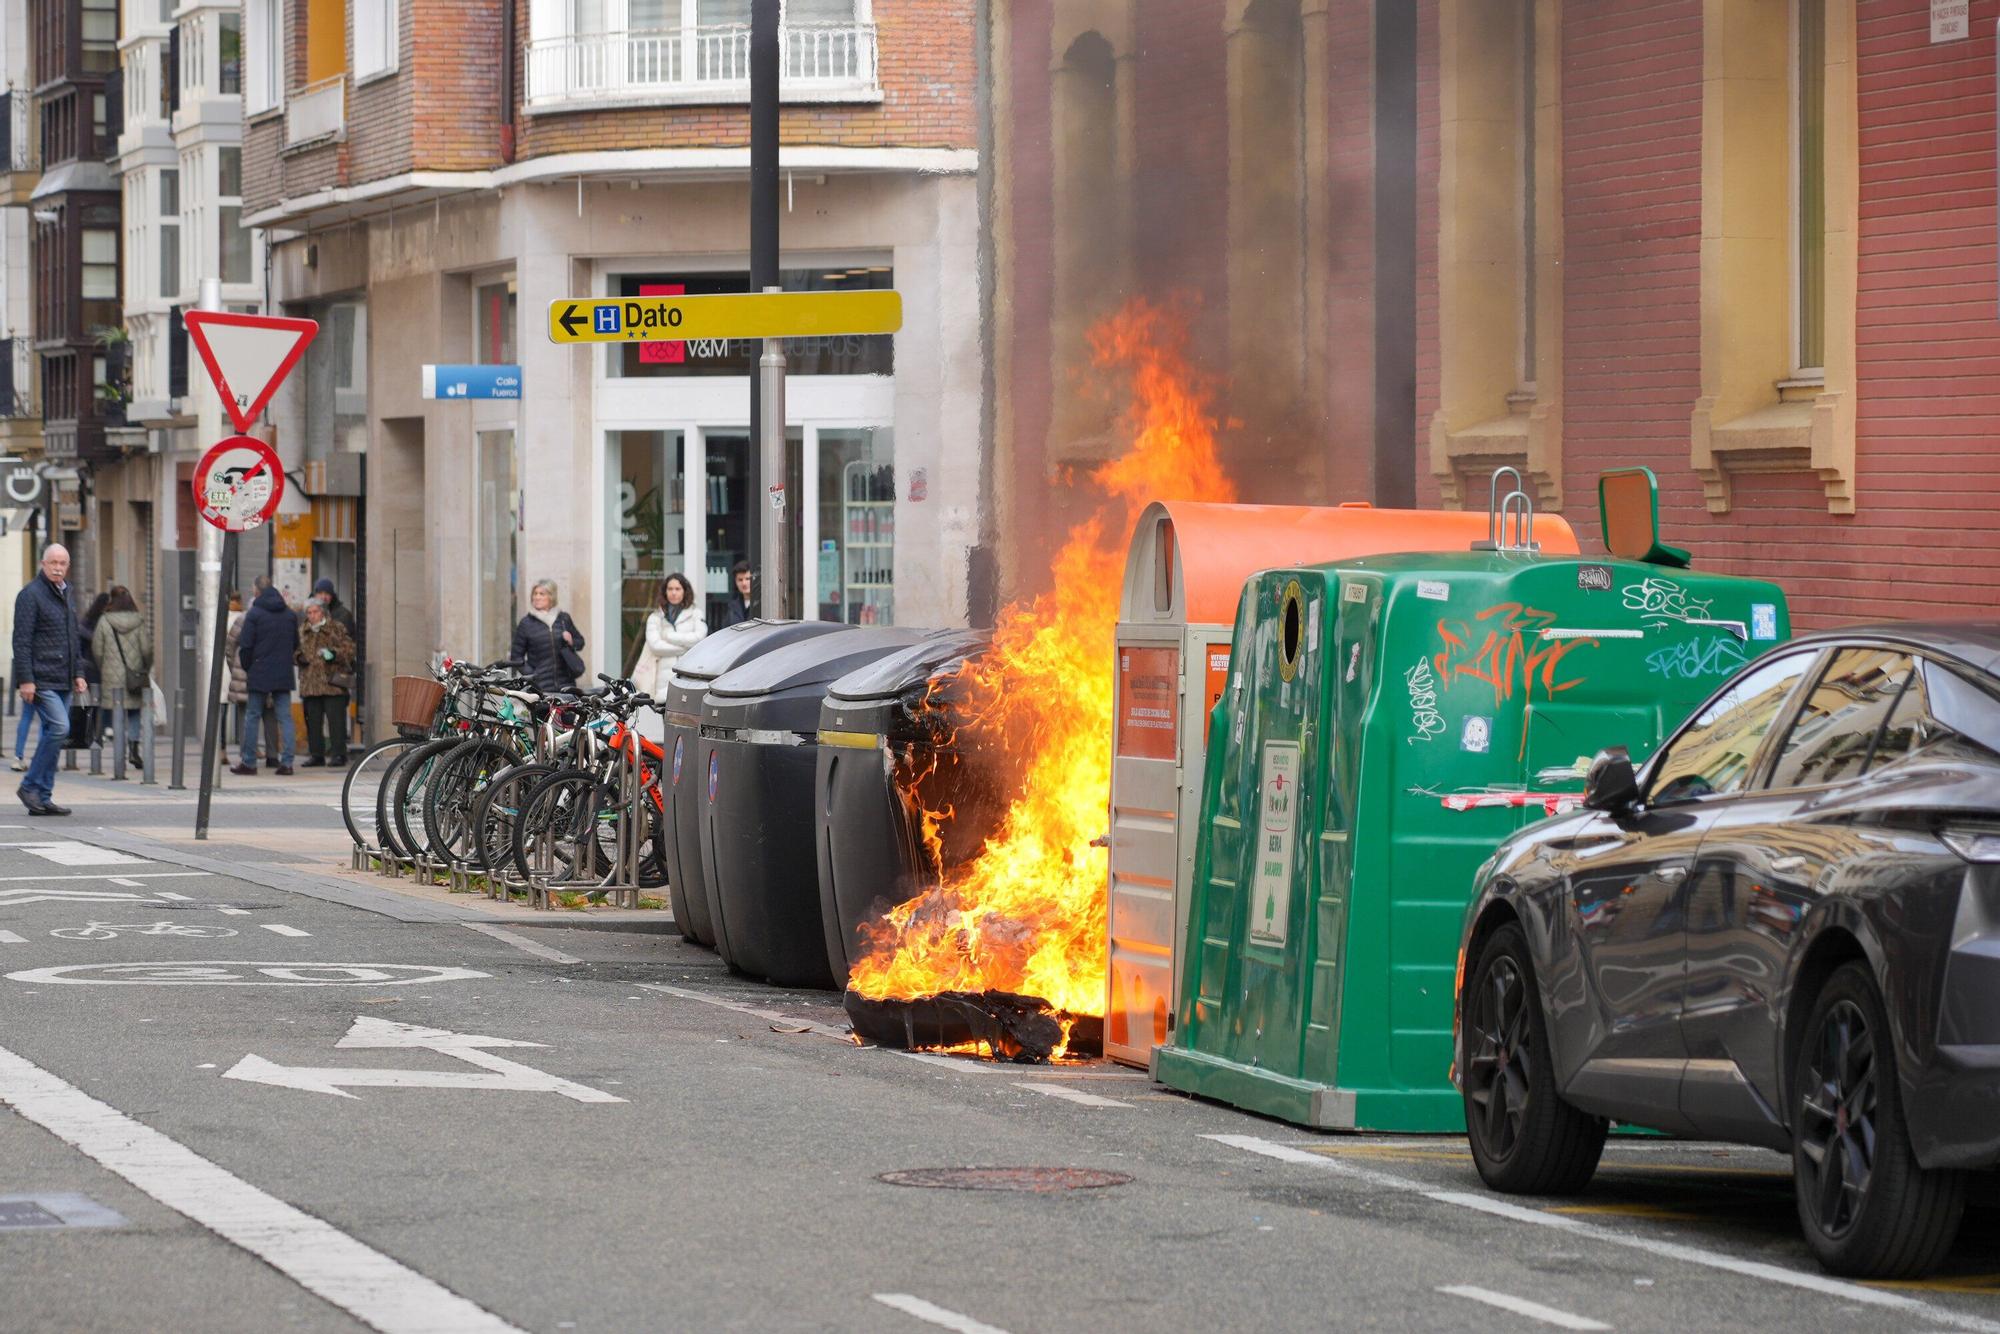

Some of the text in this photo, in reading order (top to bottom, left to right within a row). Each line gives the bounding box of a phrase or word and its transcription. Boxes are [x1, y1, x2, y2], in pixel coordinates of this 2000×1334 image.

[625, 303, 683, 328] Dato
[496, 377, 518, 387] Calle
[492, 388, 518, 397] Fueros
